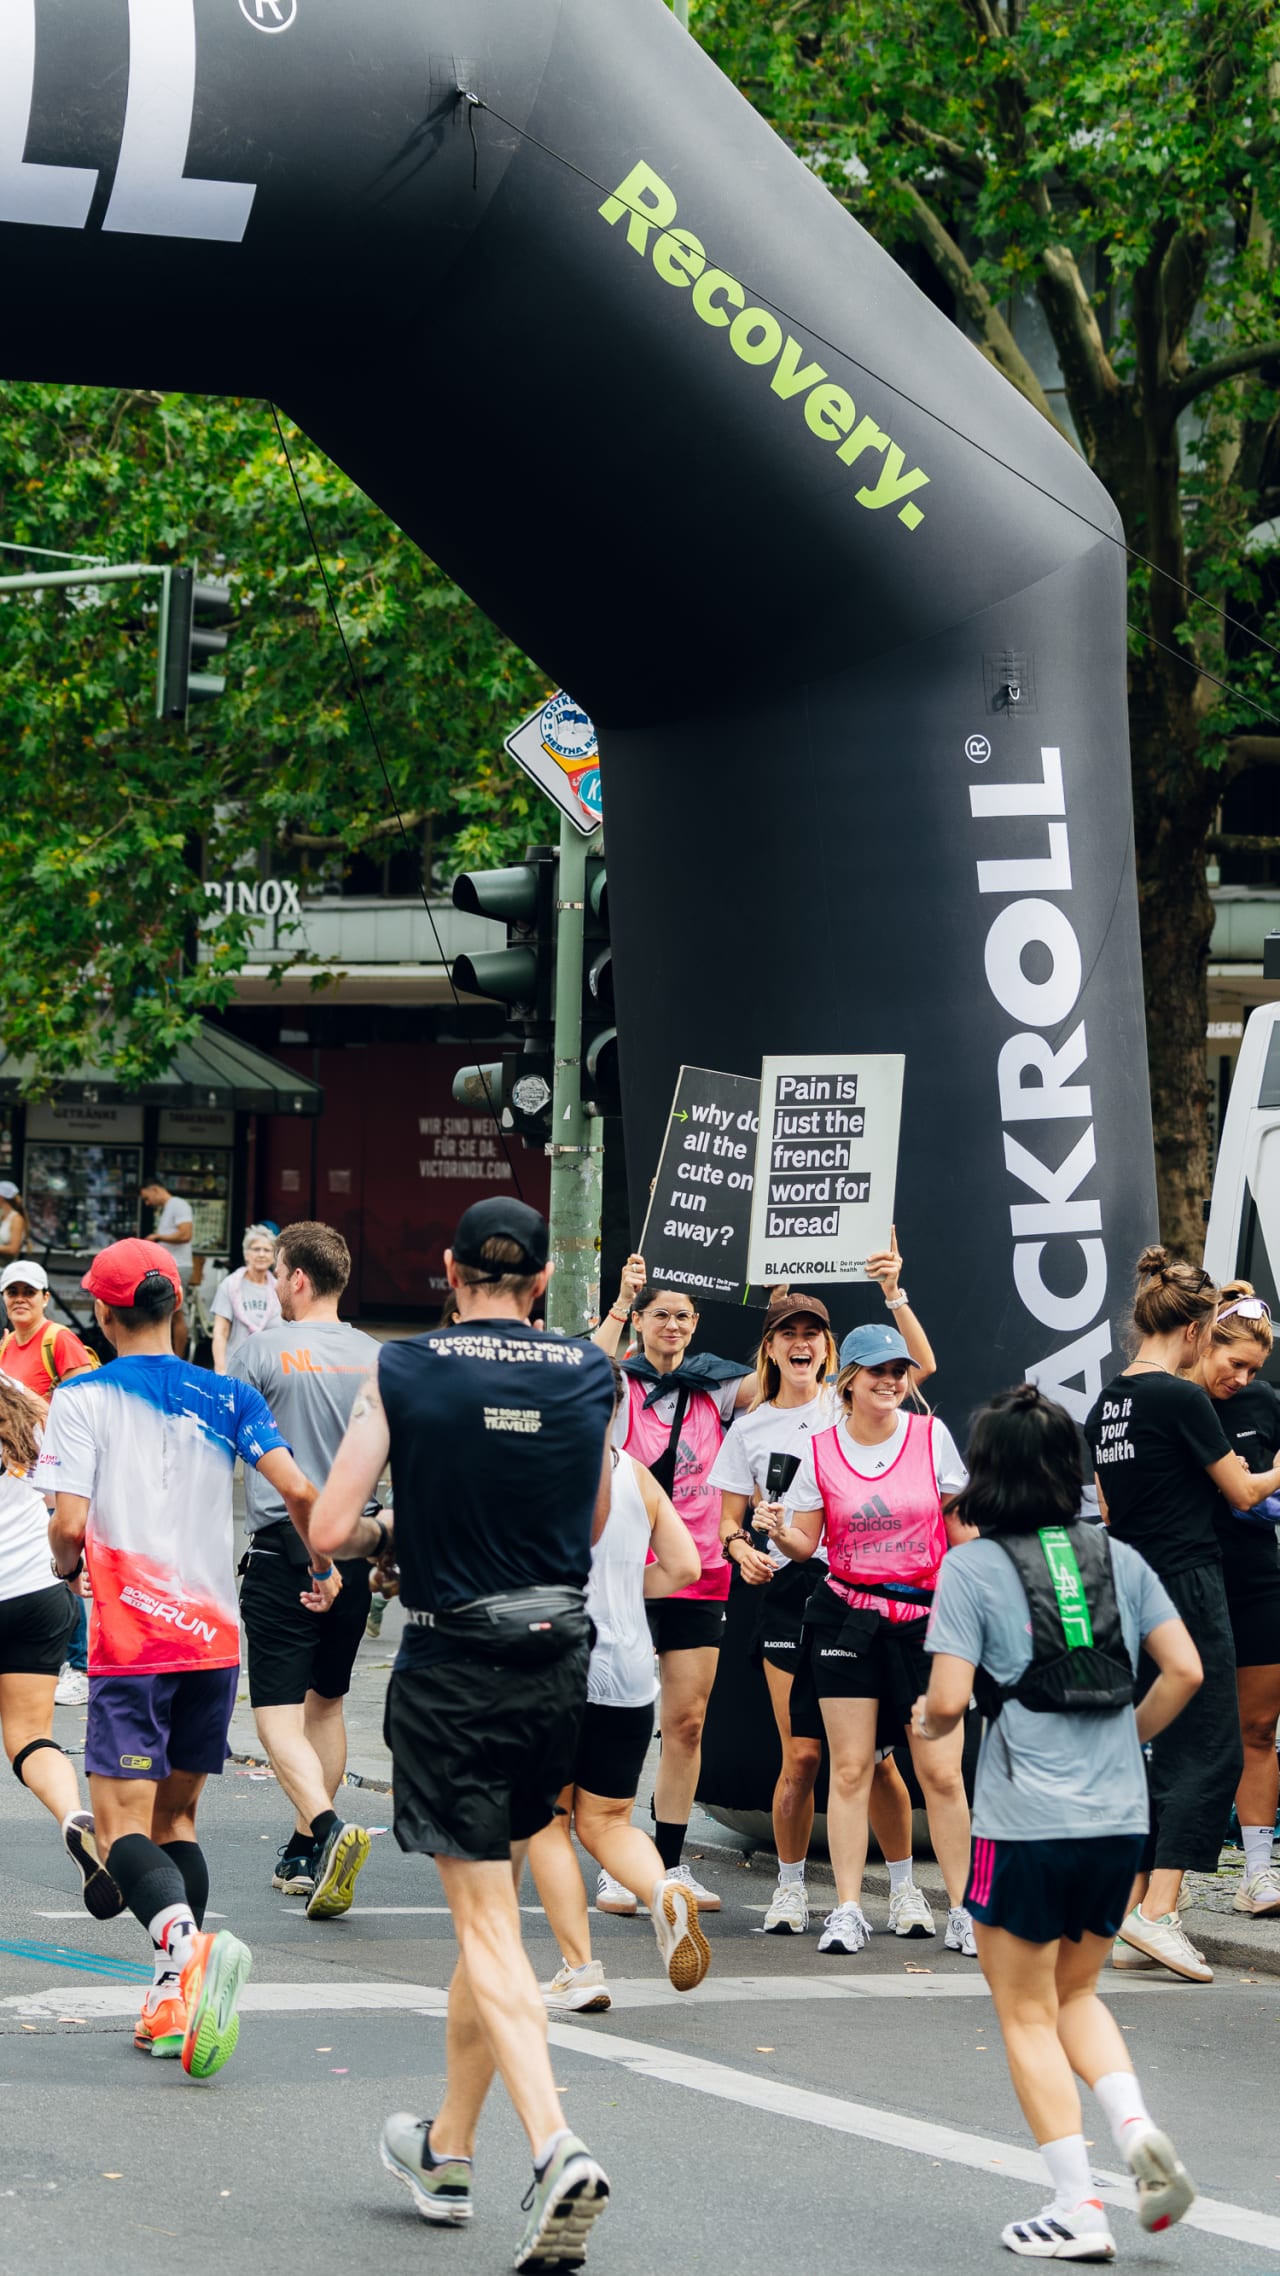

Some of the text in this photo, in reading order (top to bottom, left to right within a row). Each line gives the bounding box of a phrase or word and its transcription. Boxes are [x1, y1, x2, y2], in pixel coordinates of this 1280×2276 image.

[598, 159, 930, 532] Recovery.
[544, 732, 598, 755] HERTHA BS
[587, 777, 602, 801] K
[778, 1076, 856, 1101] Pain is
[443, 1118, 470, 1135] SIND
[691, 1103, 734, 1131] why
[773, 1109, 864, 1139] just the
[434, 1136, 456, 1156] FÜR
[459, 1140, 476, 1157] SIE
[683, 1132, 747, 1160] all the
[773, 1144, 850, 1169] french
[419, 1160, 512, 1179] VICTORINOX.COM
[677, 1162, 754, 1192] cute on
[669, 1190, 707, 1212] run
[771, 1177, 870, 1203] word for
[663, 1219, 734, 1247] away?
[769, 1211, 839, 1236] bread
[652, 1266, 714, 1288] BLACKROLL
[765, 1261, 837, 1275] BLACKROLL
[428, 1336, 585, 1360] DISCOVER THE WORLD
[453, 1346, 496, 1361] YOUR
[498, 1349, 544, 1362] PLACE
[547, 1352, 563, 1363] IN
[280, 1349, 323, 1375] NL
[1102, 1398, 1132, 1421] Do it
[1100, 1421, 1128, 1445] your
[1095, 1439, 1135, 1465] health
[847, 1516, 902, 1533] adidas
[863, 1541, 927, 1554] EVENTS
[122, 1585, 160, 1608] BORN
[152, 1602, 218, 1642] RUN
